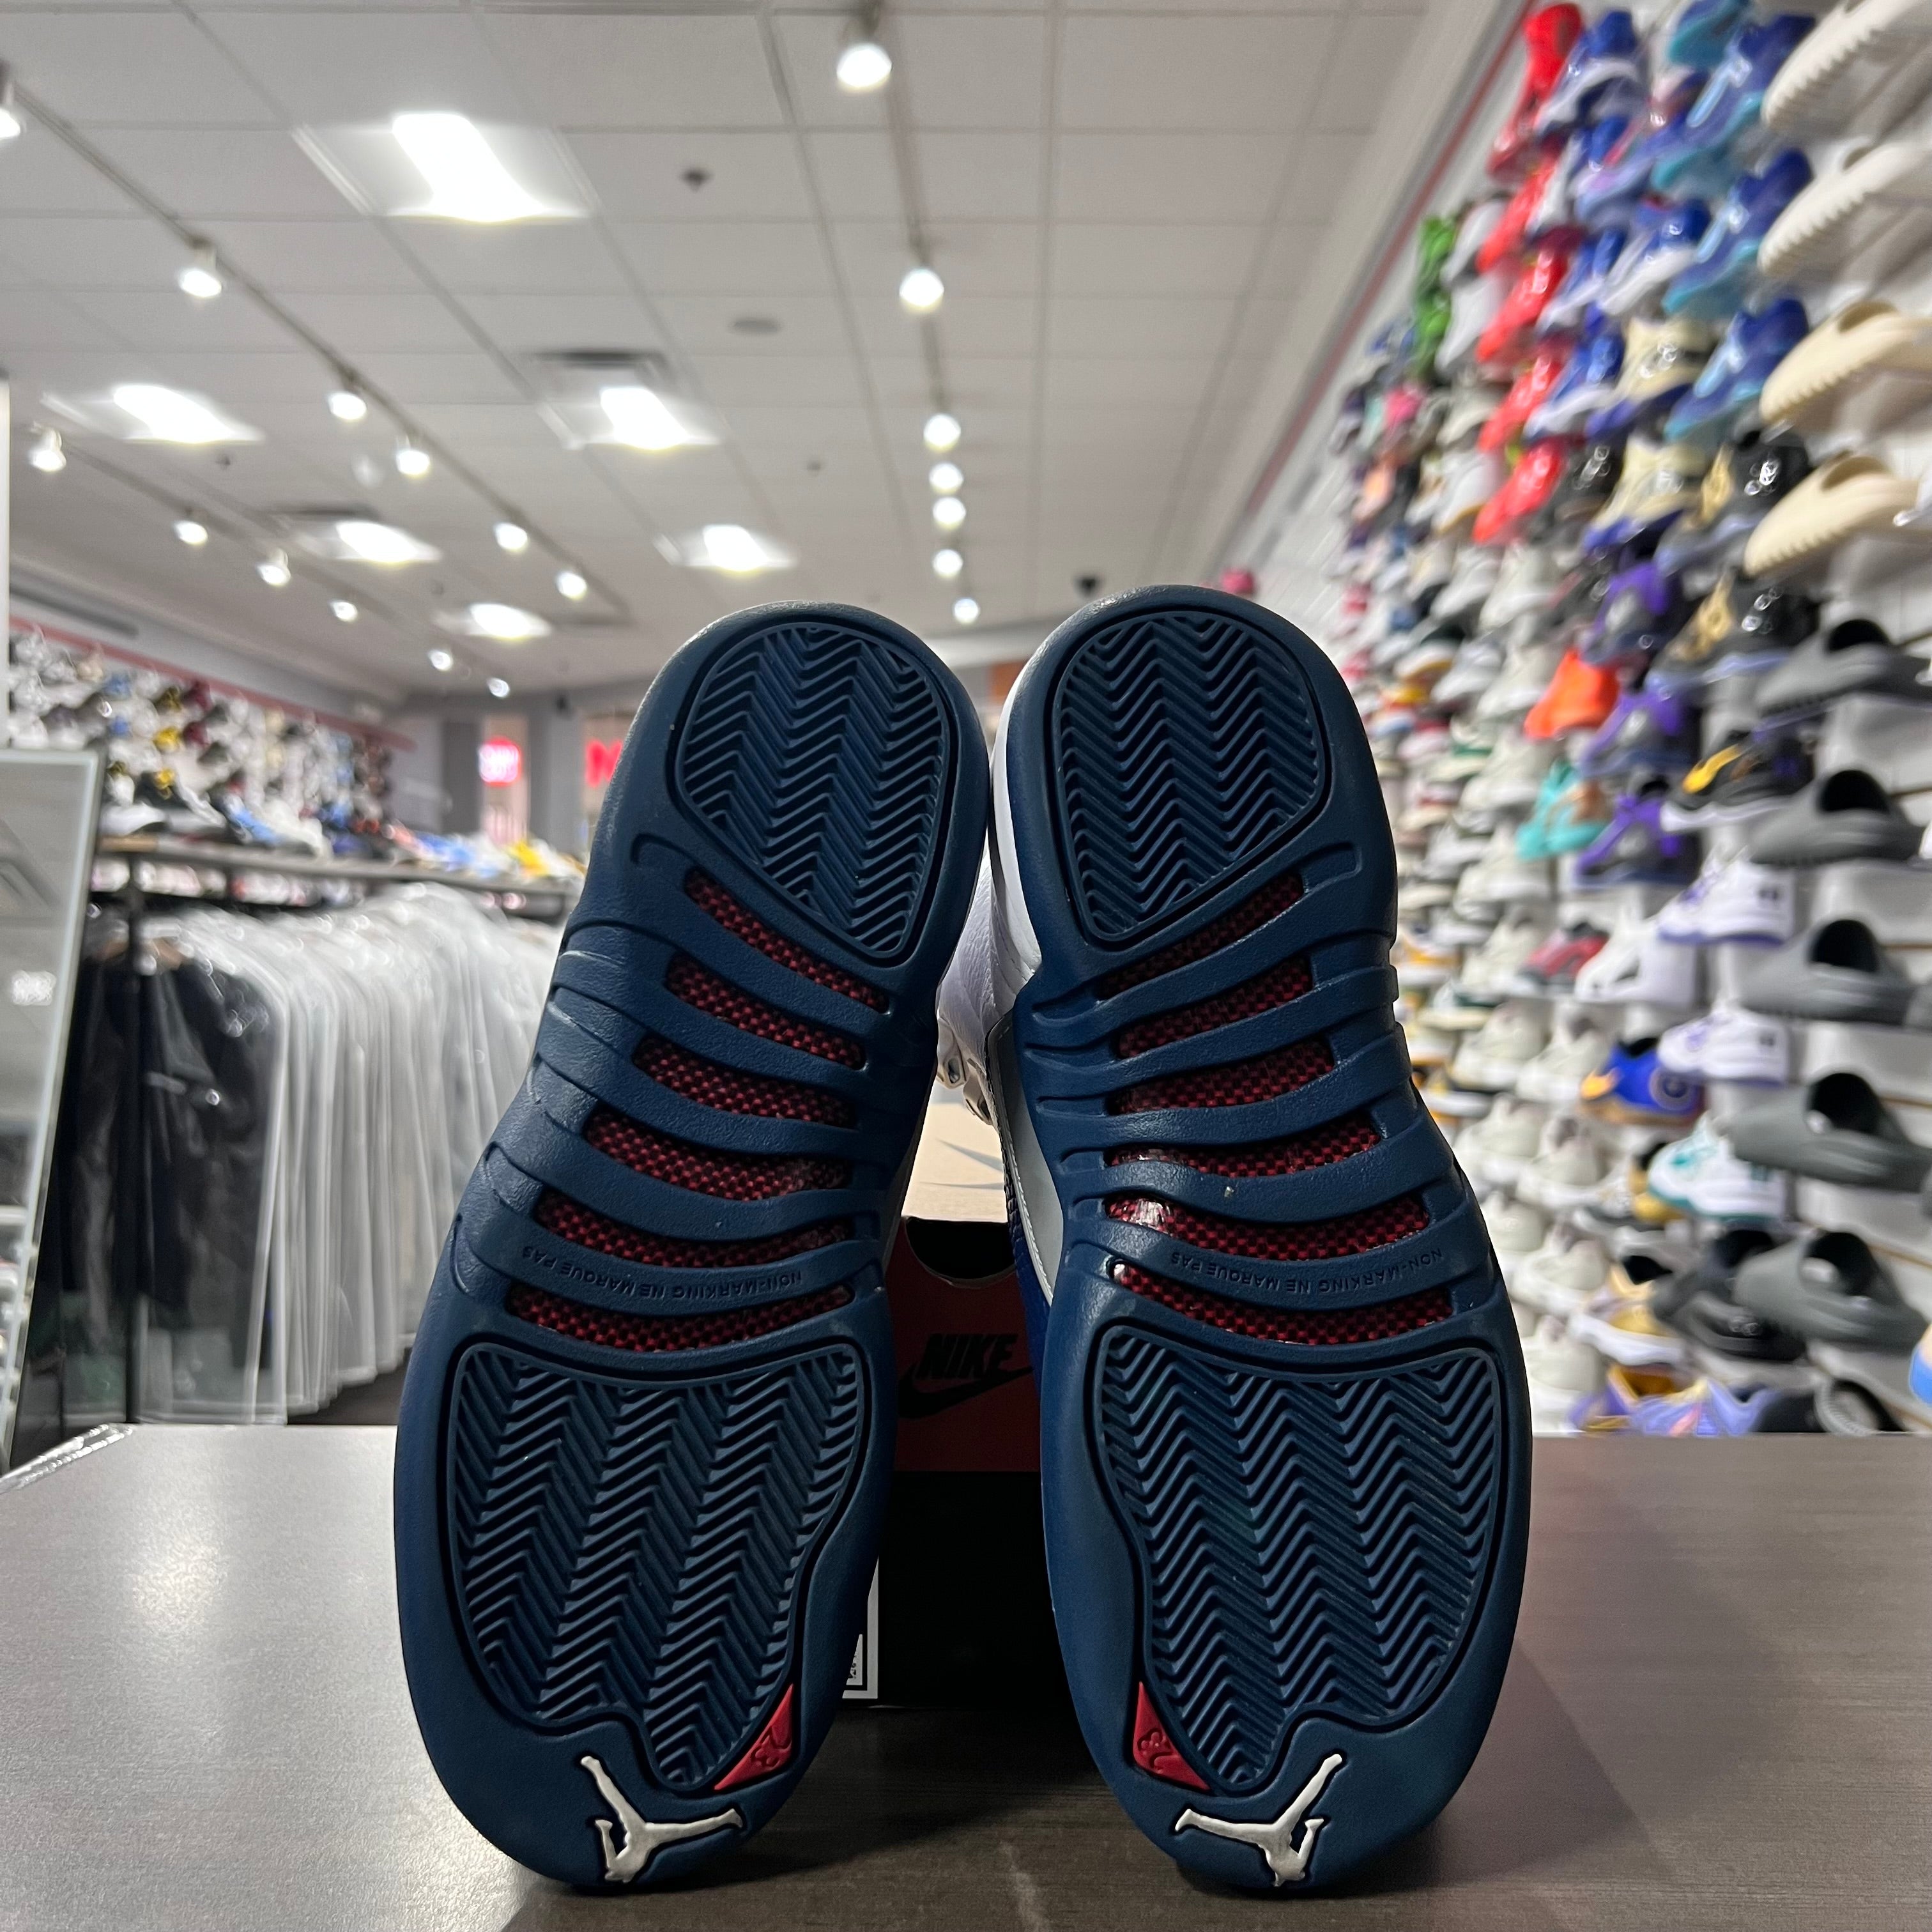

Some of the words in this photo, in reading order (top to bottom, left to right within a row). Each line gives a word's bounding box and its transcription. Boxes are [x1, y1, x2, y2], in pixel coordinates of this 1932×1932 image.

[523, 1246, 558, 1270] PAS
[1170, 1251, 1204, 1271] PAS
[1318, 1247, 1442, 1293] NON-MARKING
[560, 1262, 636, 1296] MARQUE
[673, 1271, 803, 1300] NON-MARKING
[1207, 1263, 1280, 1291] MARQUE
[1285, 1278, 1311, 1293] NE
[640, 1284, 666, 1300] NE
[917, 1334, 1018, 1379] NIKE
